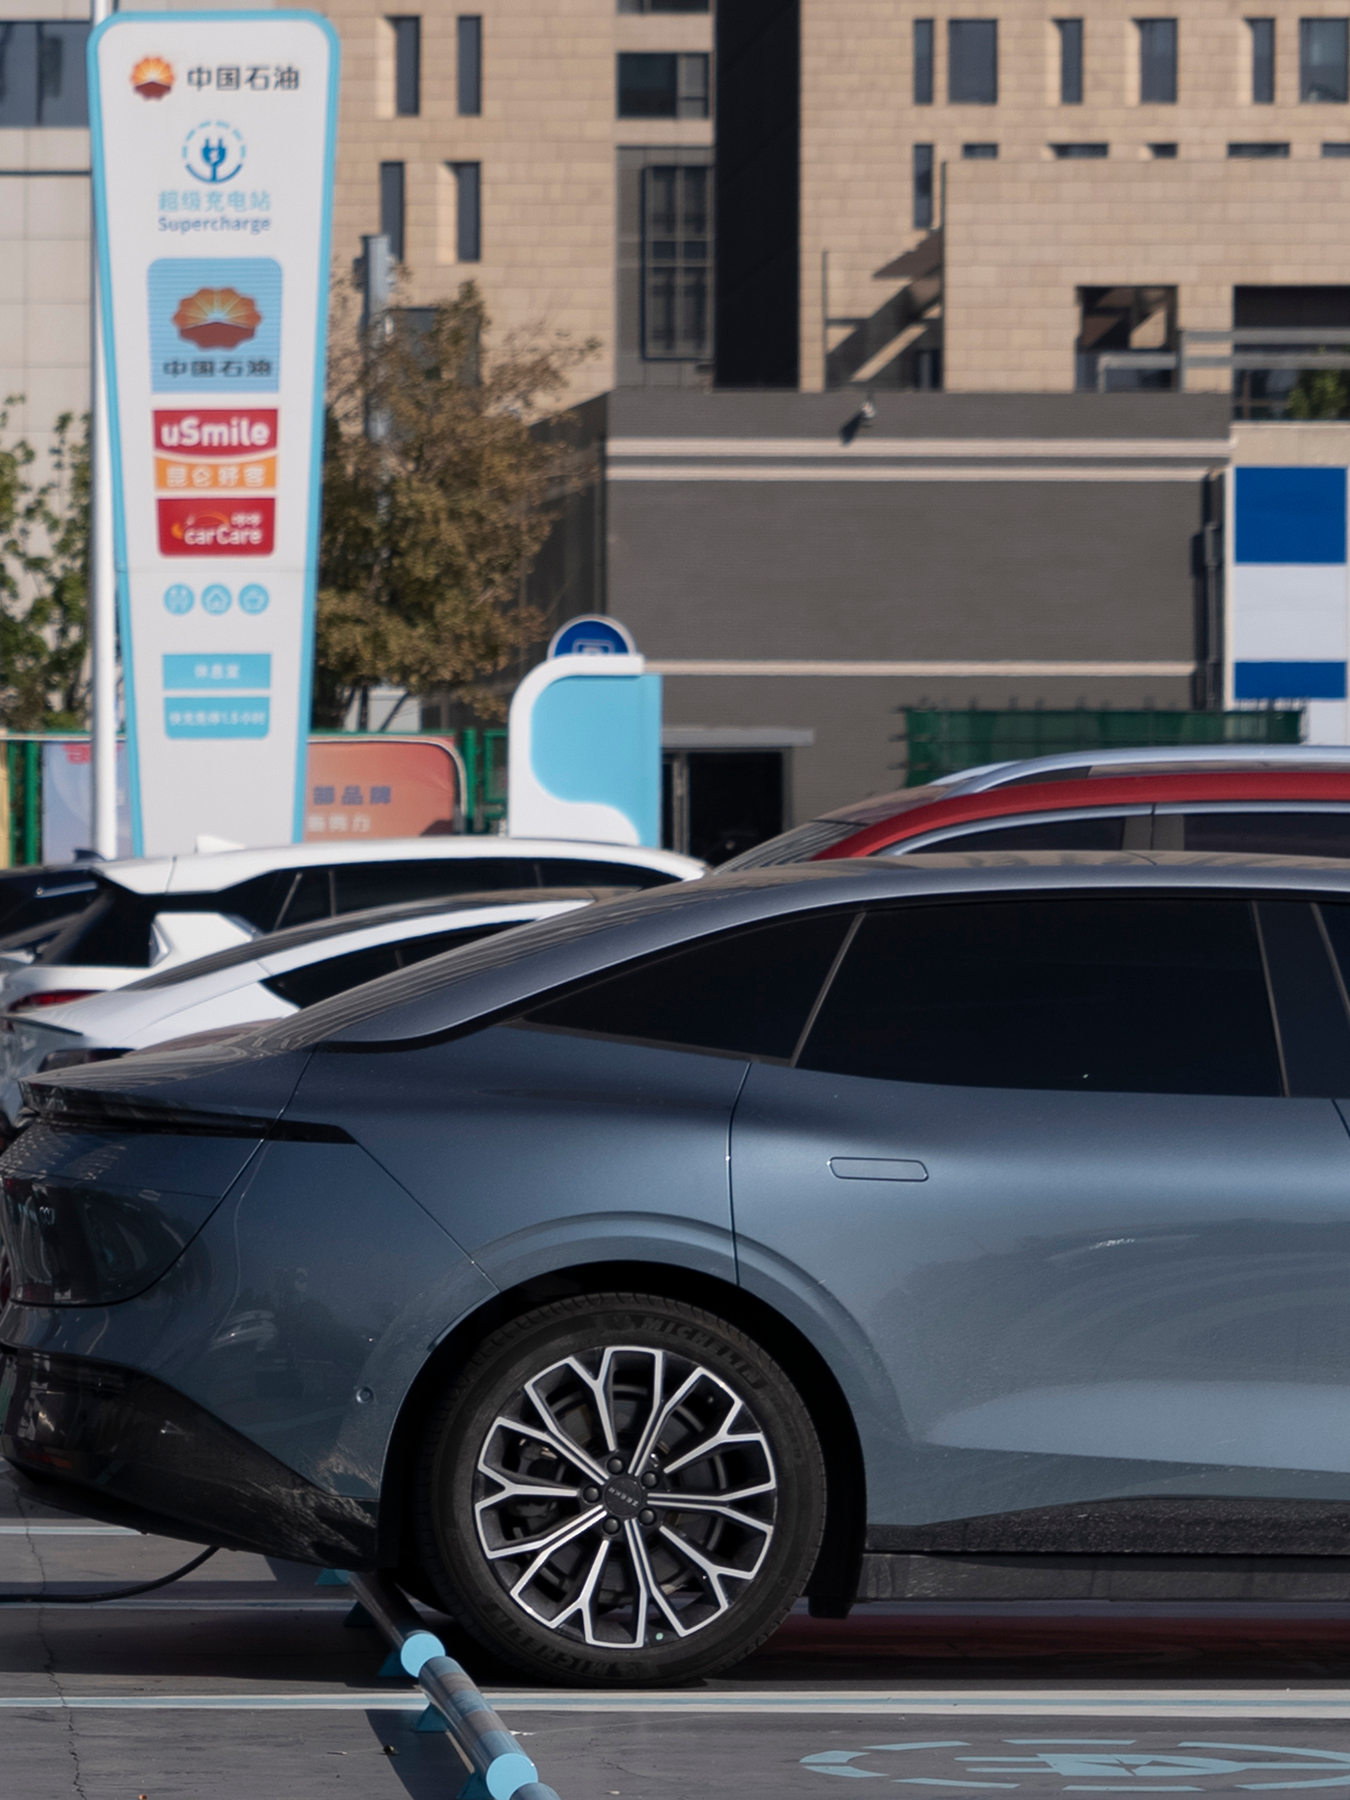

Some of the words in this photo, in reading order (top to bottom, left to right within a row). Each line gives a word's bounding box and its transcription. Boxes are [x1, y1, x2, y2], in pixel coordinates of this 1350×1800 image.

[186, 66, 300, 91] 中国石油
[158, 190, 271, 213] 超级充电站
[157, 215, 271, 235] Supercharge
[164, 358, 273, 378] 中国石油
[161, 416, 271, 446] uSmile
[166, 466, 265, 487] 昆仑好客
[183, 524, 263, 545] carCare
